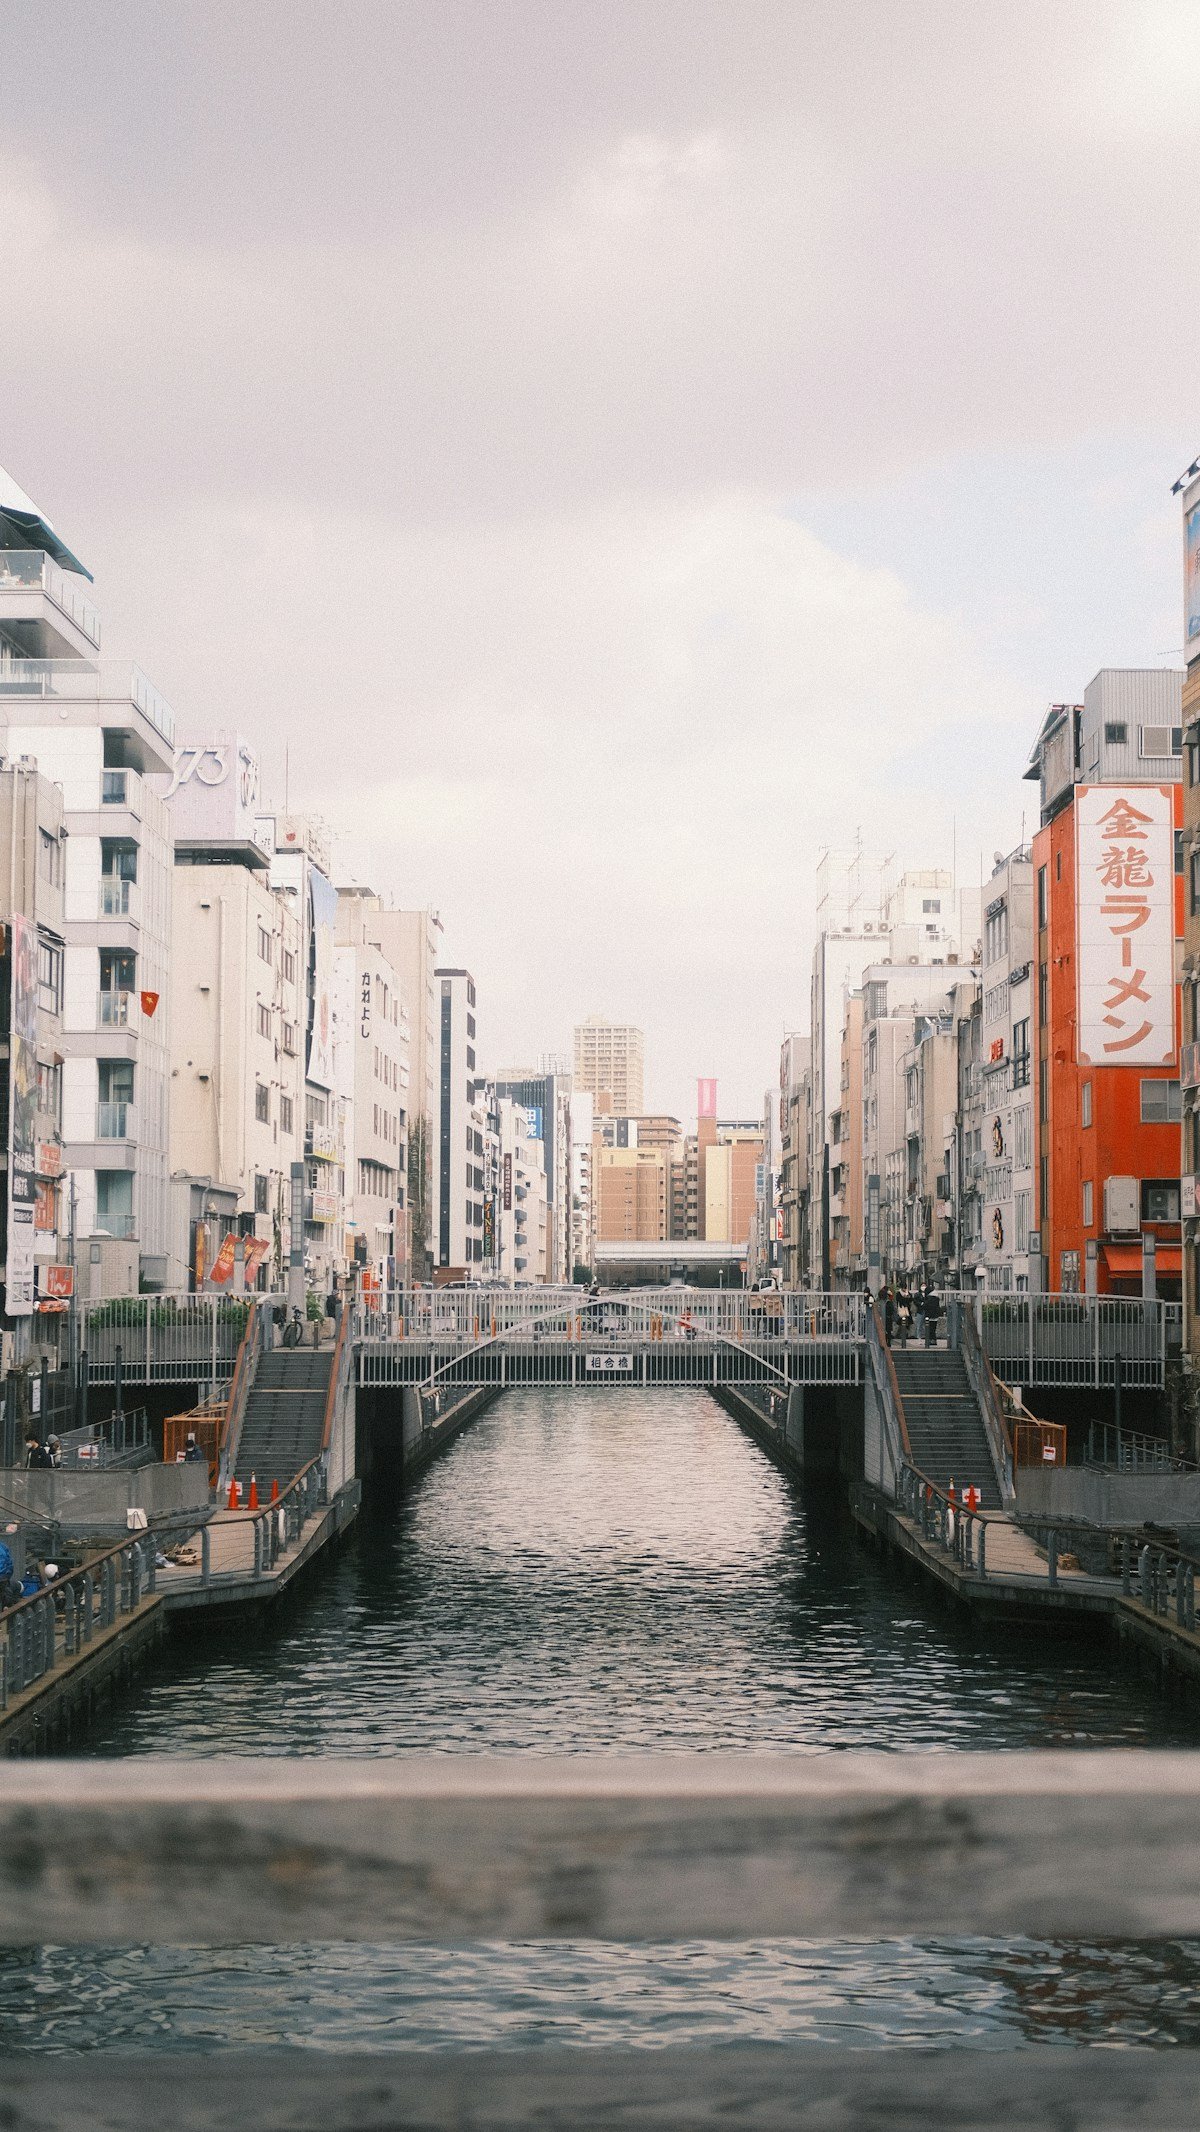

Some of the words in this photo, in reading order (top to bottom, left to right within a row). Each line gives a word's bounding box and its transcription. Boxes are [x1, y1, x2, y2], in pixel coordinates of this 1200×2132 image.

[1096, 798, 1154, 1053] 金龍ラーメン
[361, 972, 371, 1039] かねよし
[591, 1357, 628, 1368] 相合橋
